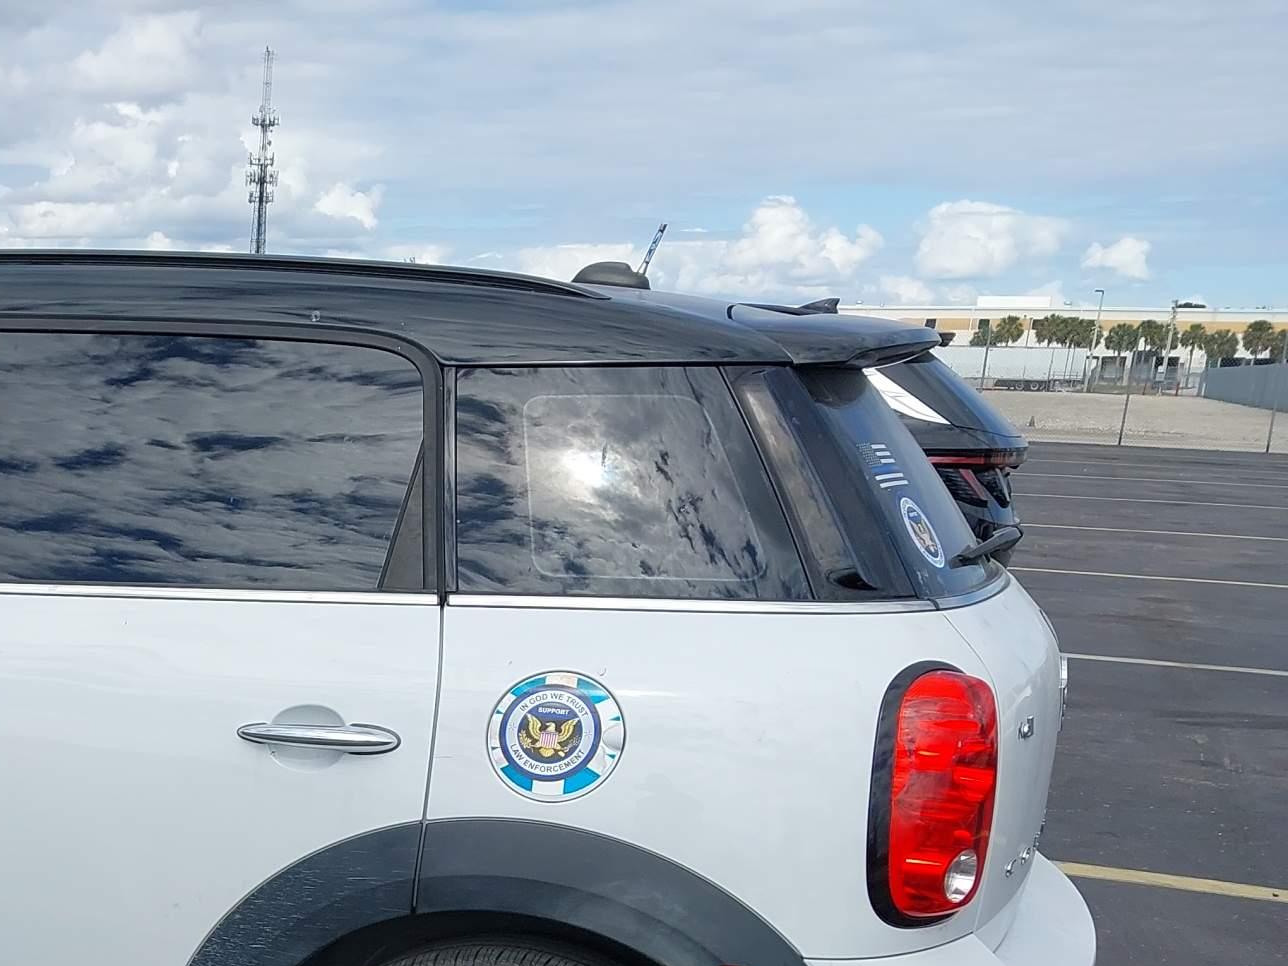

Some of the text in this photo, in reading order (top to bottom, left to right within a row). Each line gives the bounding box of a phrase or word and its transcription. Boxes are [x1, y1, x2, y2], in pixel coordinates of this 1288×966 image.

[520, 692, 589, 717] IN GOD WE TRUST
[538, 706, 571, 715] SUPPORT
[511, 743, 585, 774] LAW ENFORCEMENT
